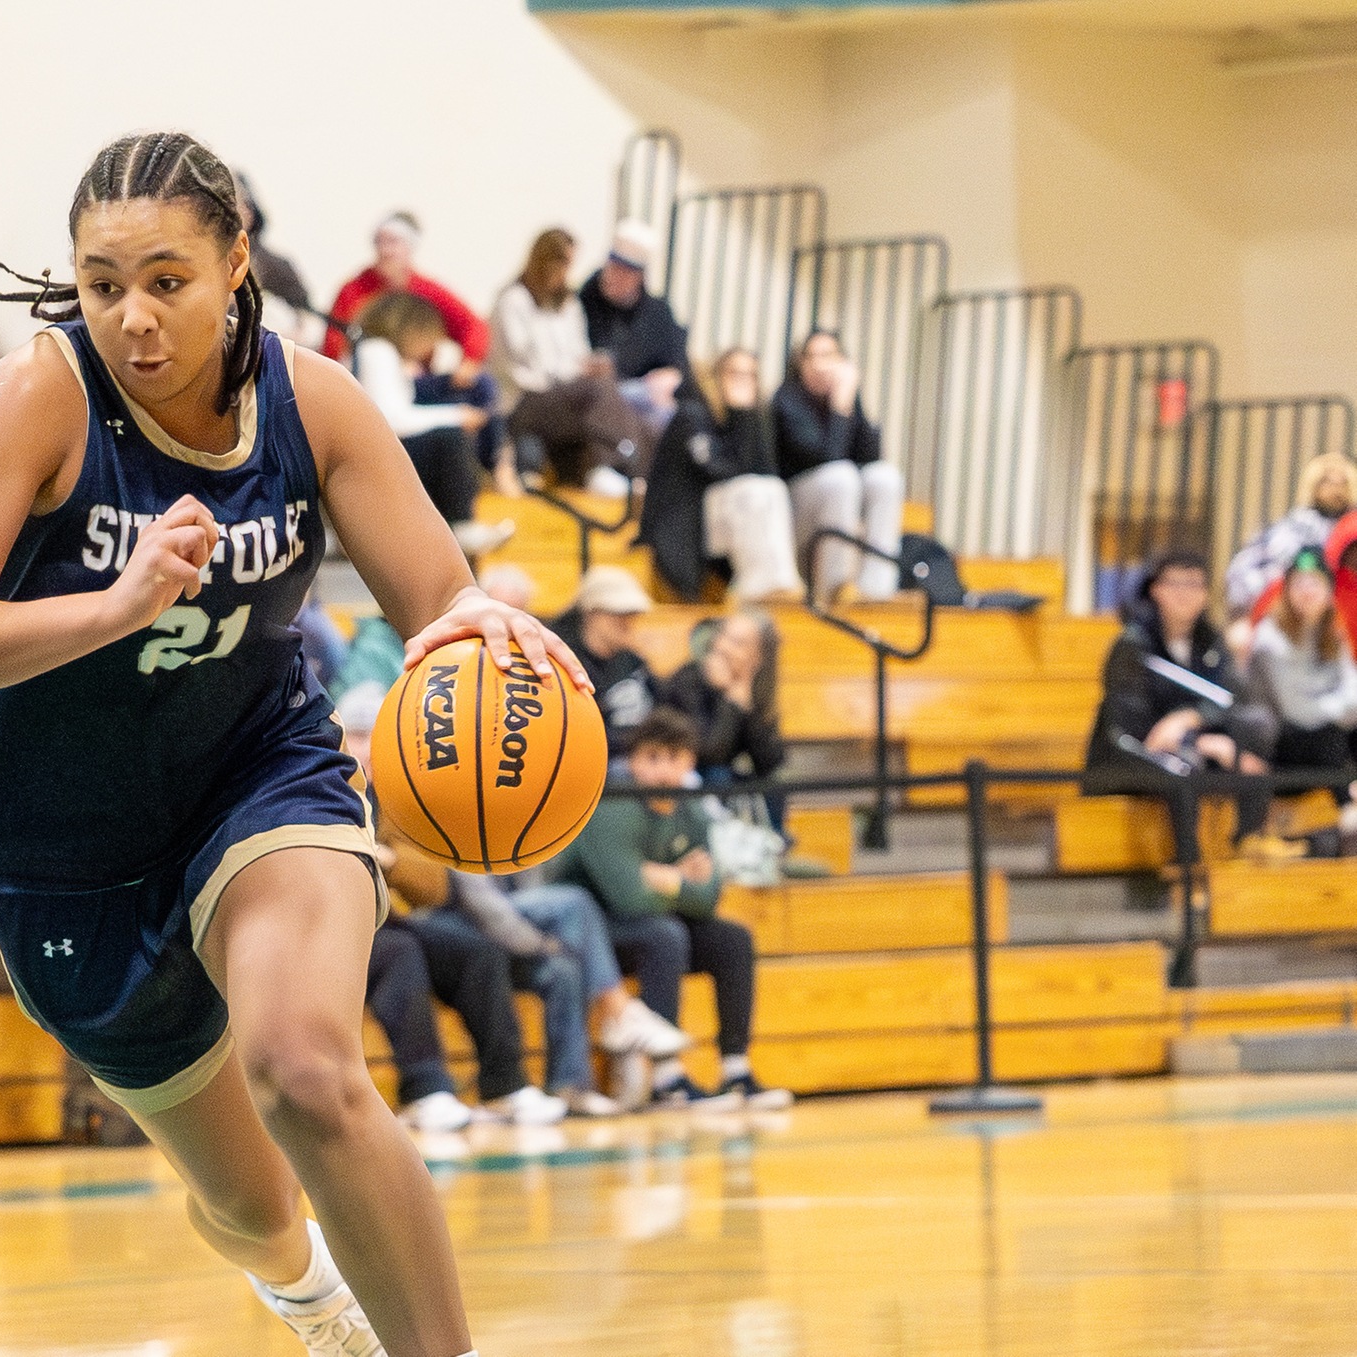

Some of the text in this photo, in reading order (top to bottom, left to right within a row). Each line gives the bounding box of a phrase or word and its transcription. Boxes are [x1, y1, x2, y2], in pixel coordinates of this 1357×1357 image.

[82, 500, 308, 584] SUFOLK
[137, 604, 252, 675] 21
[424, 664, 460, 771] NCAA
